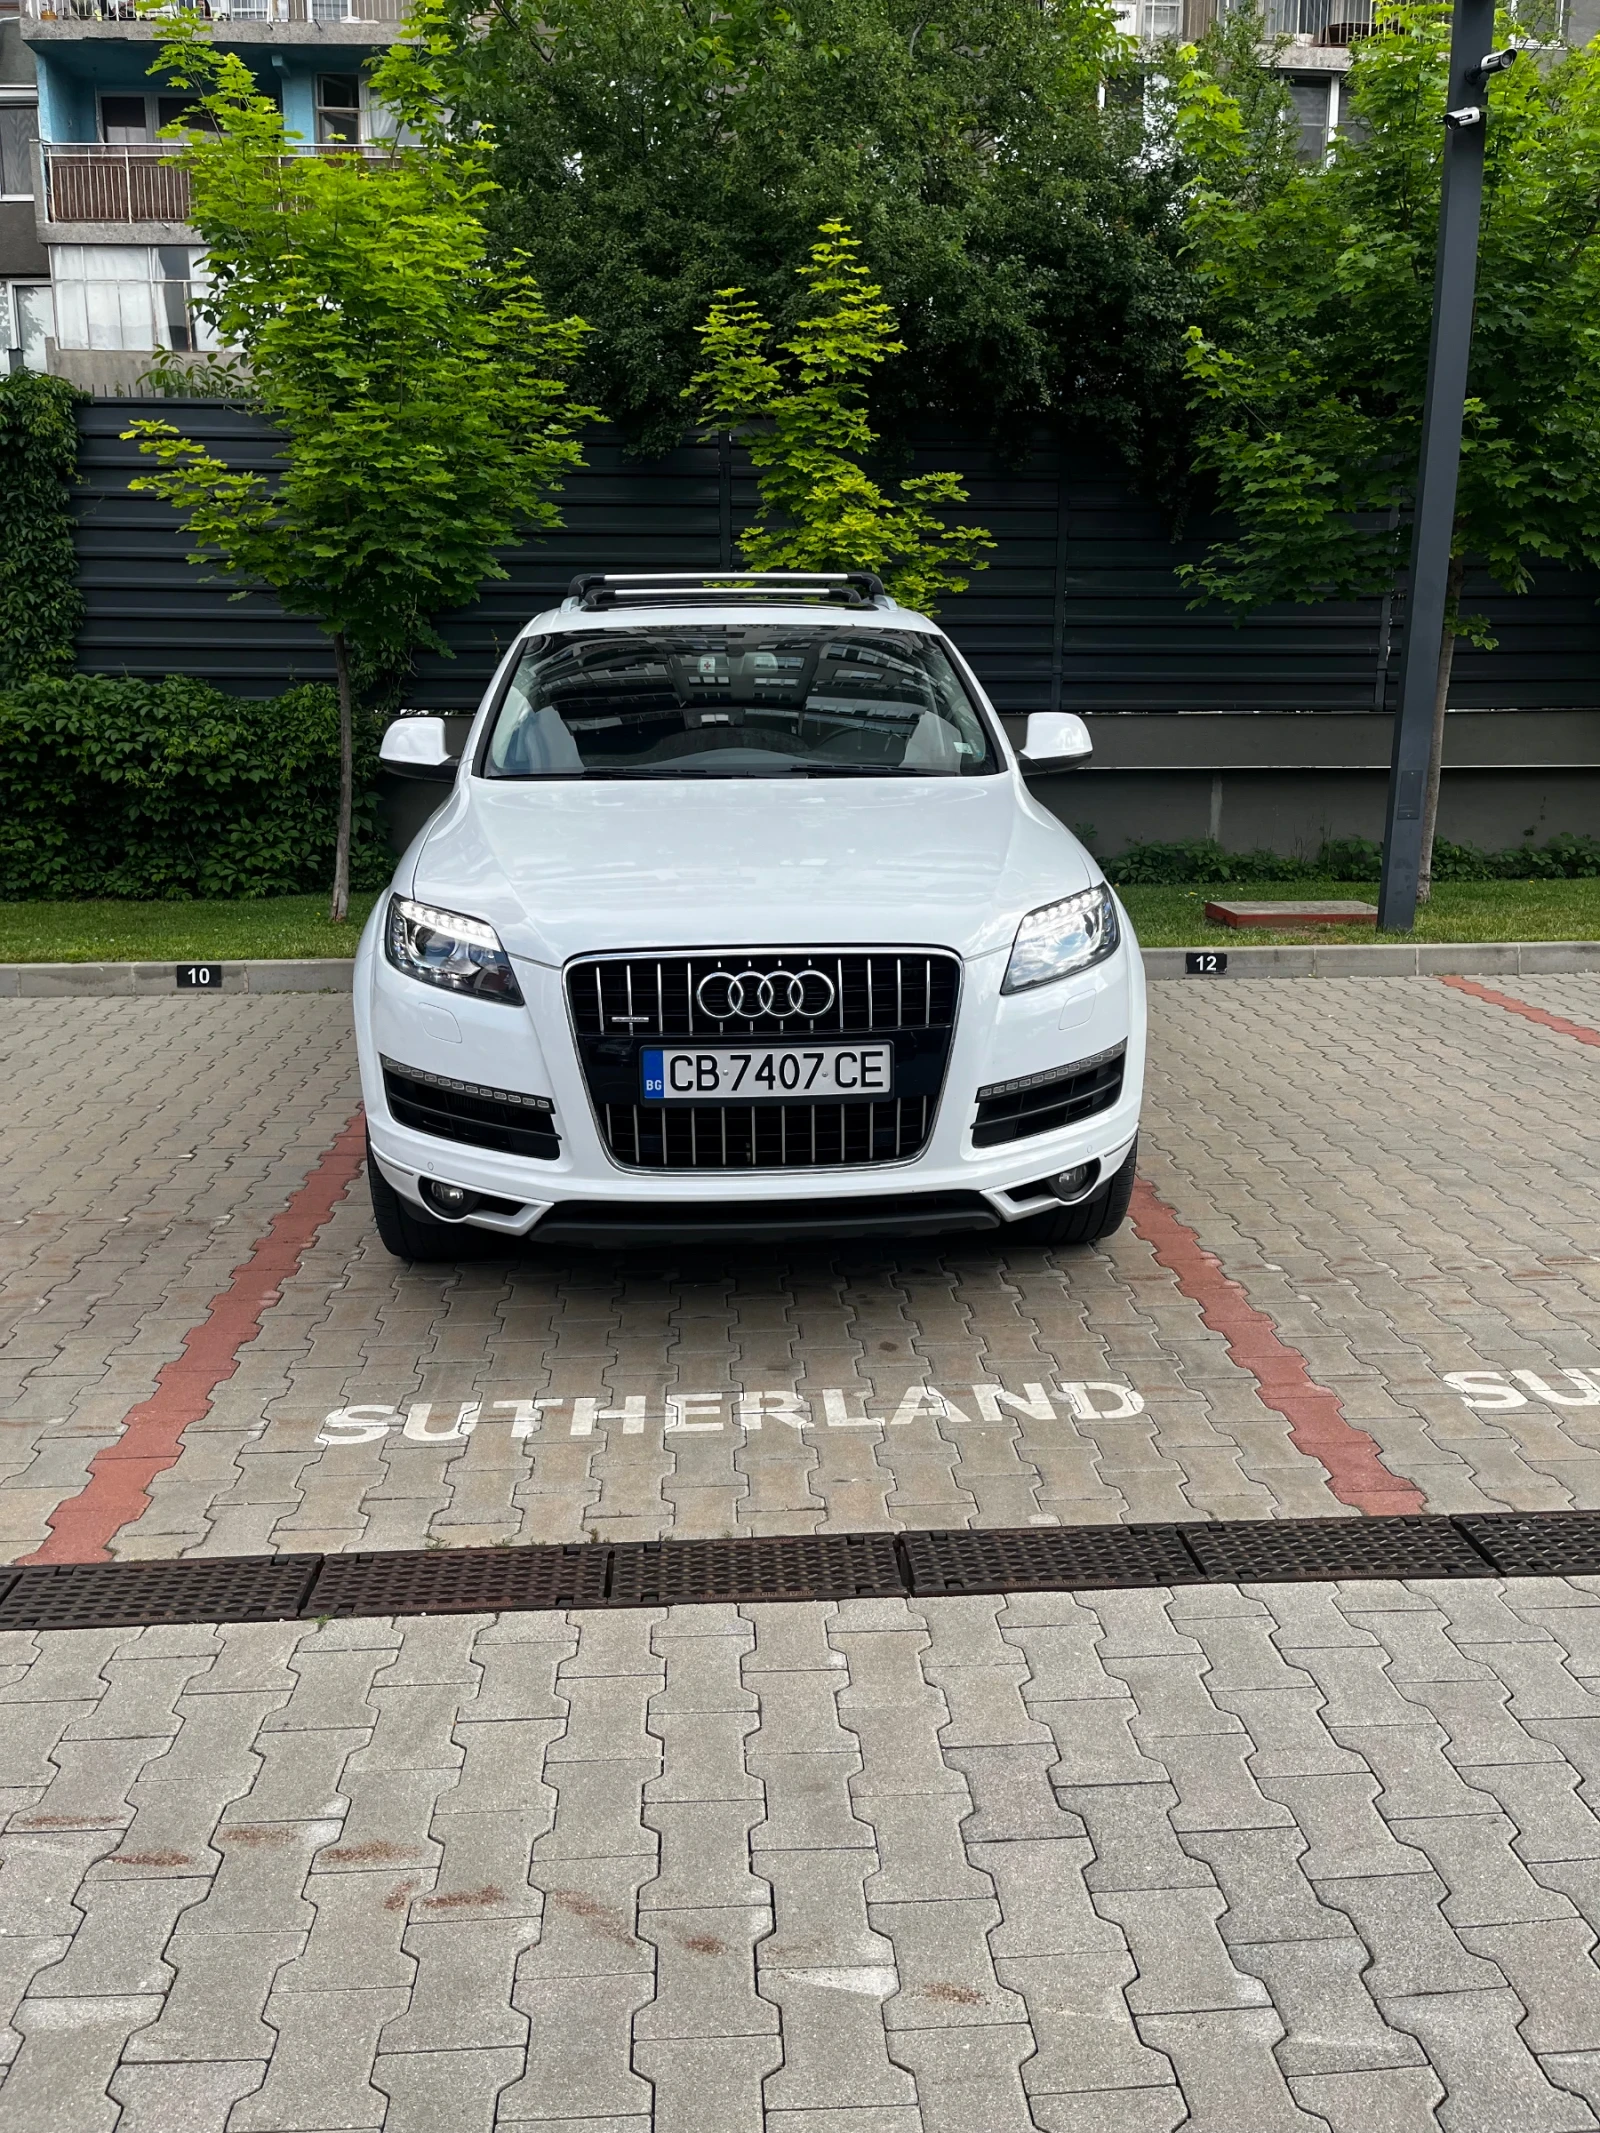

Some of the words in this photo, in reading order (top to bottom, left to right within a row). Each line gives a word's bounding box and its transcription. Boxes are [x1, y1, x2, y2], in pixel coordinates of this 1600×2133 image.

[187, 967, 210, 984] 10
[1196, 955, 1217, 971] 12
[646, 1079, 662, 1091] BG
[669, 1054, 720, 1091] CB
[730, 1053, 824, 1091] 7407
[835, 1051, 884, 1088] CE
[1442, 1368, 1600, 1408] SU
[314, 1382, 1145, 1445] SUTHERLAND
